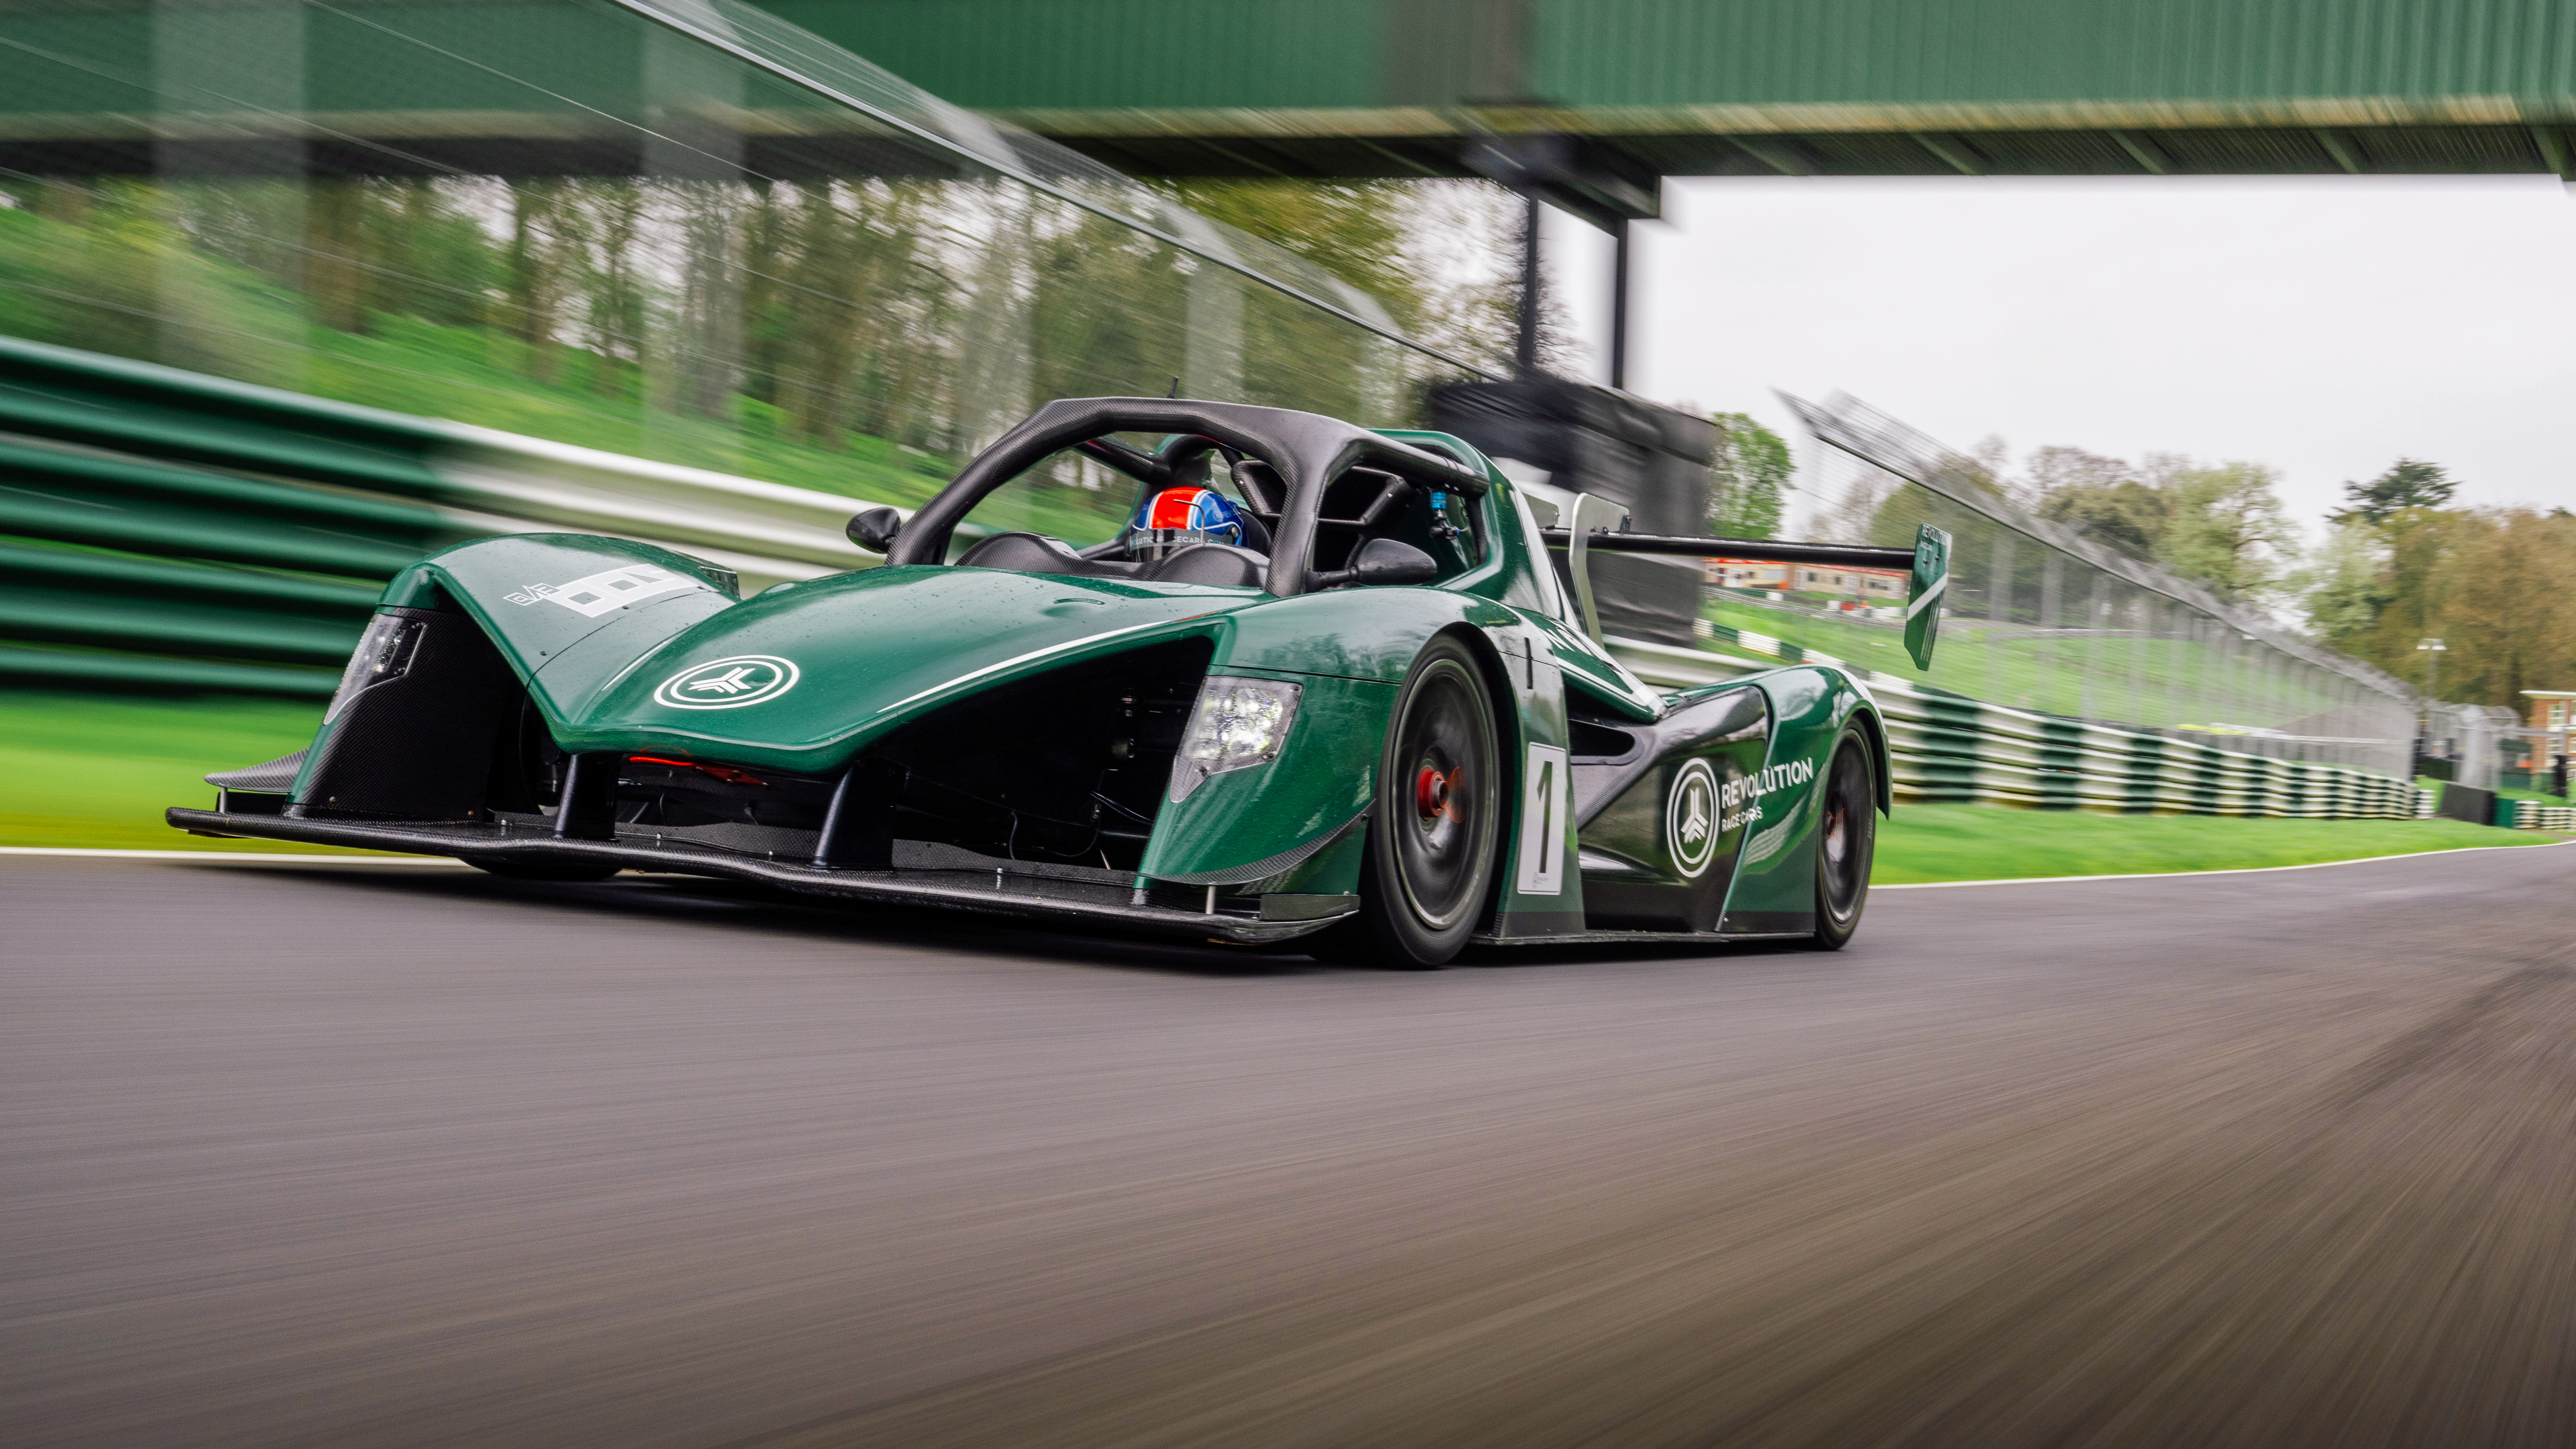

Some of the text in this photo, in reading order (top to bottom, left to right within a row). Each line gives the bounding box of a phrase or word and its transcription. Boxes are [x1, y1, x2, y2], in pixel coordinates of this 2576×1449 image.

[1722, 757, 1813, 809] REVOLUTION
[1537, 761, 1553, 873] 1
[1722, 806, 1763, 832] RACE CARS
